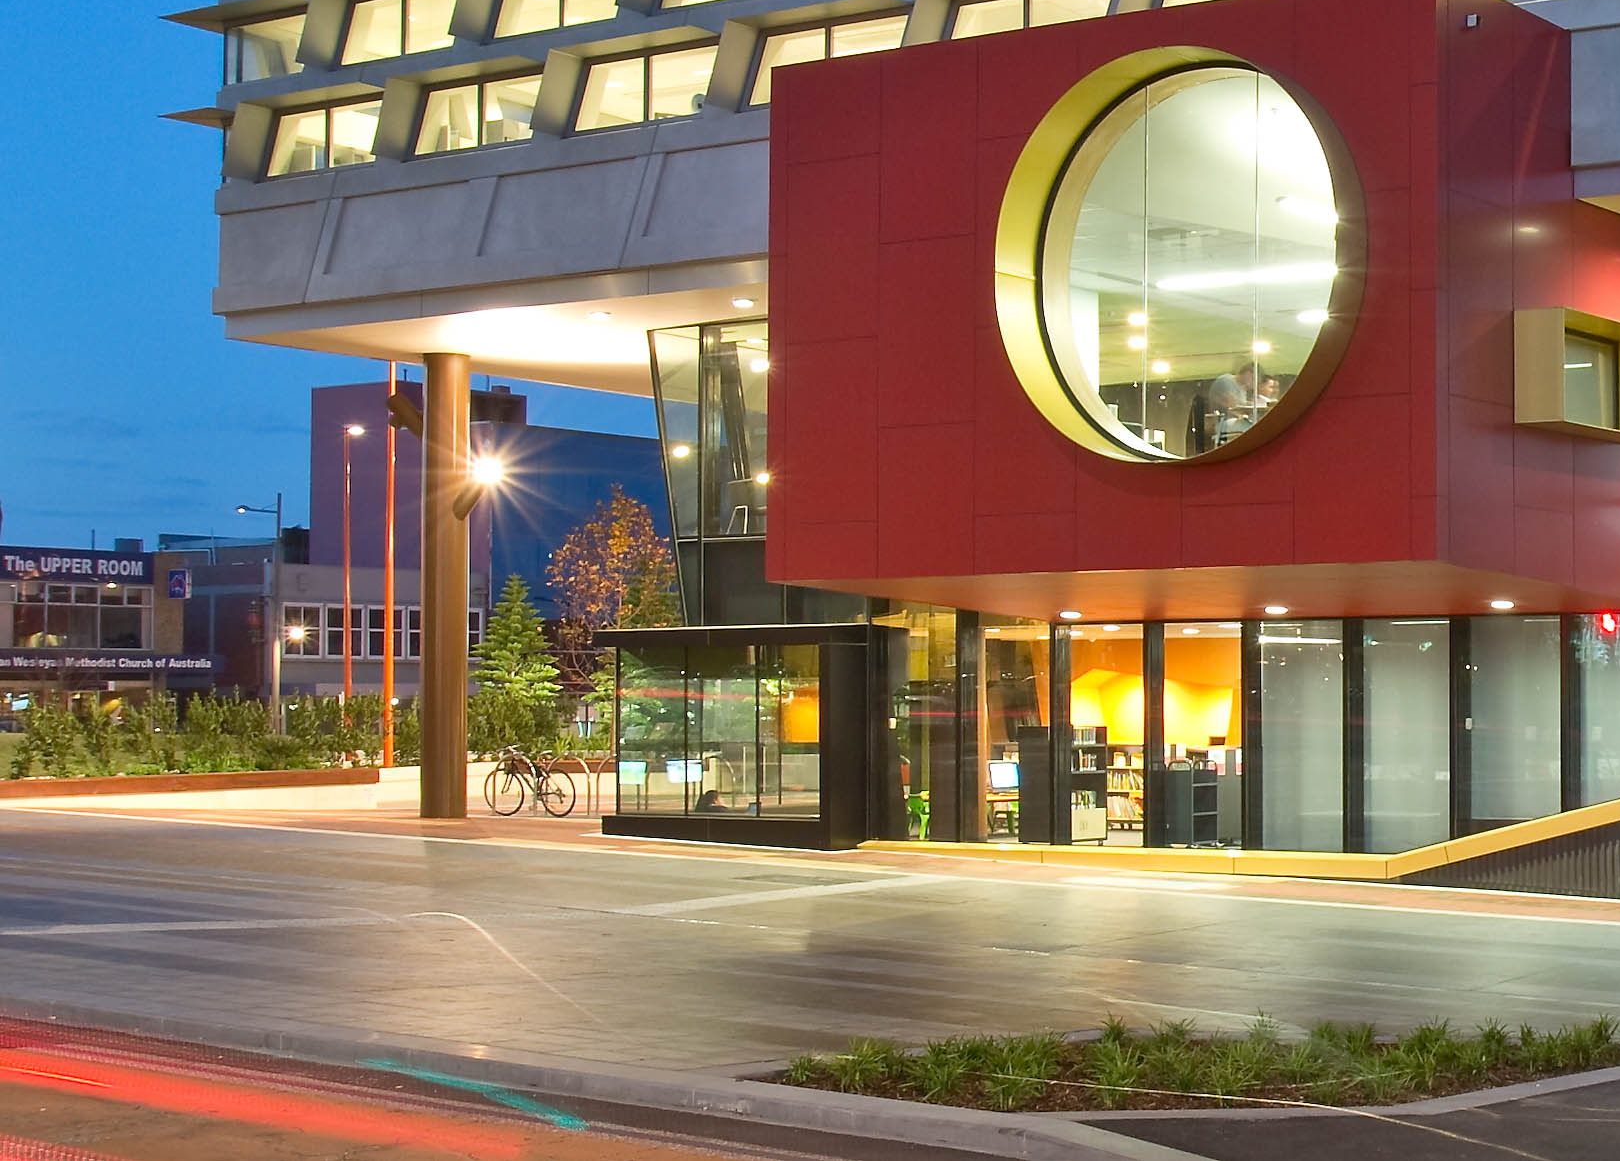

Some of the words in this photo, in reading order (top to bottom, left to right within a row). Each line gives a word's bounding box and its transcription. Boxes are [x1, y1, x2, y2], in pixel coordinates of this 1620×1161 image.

[5, 555, 34, 571] The
[41, 557, 92, 574] UPPER
[98, 559, 143, 576] ROOM
[13, 657, 63, 669] Weseya
[118, 658, 153, 668] Church
[155, 658, 166, 668] of
[168, 658, 212, 669] Australia
